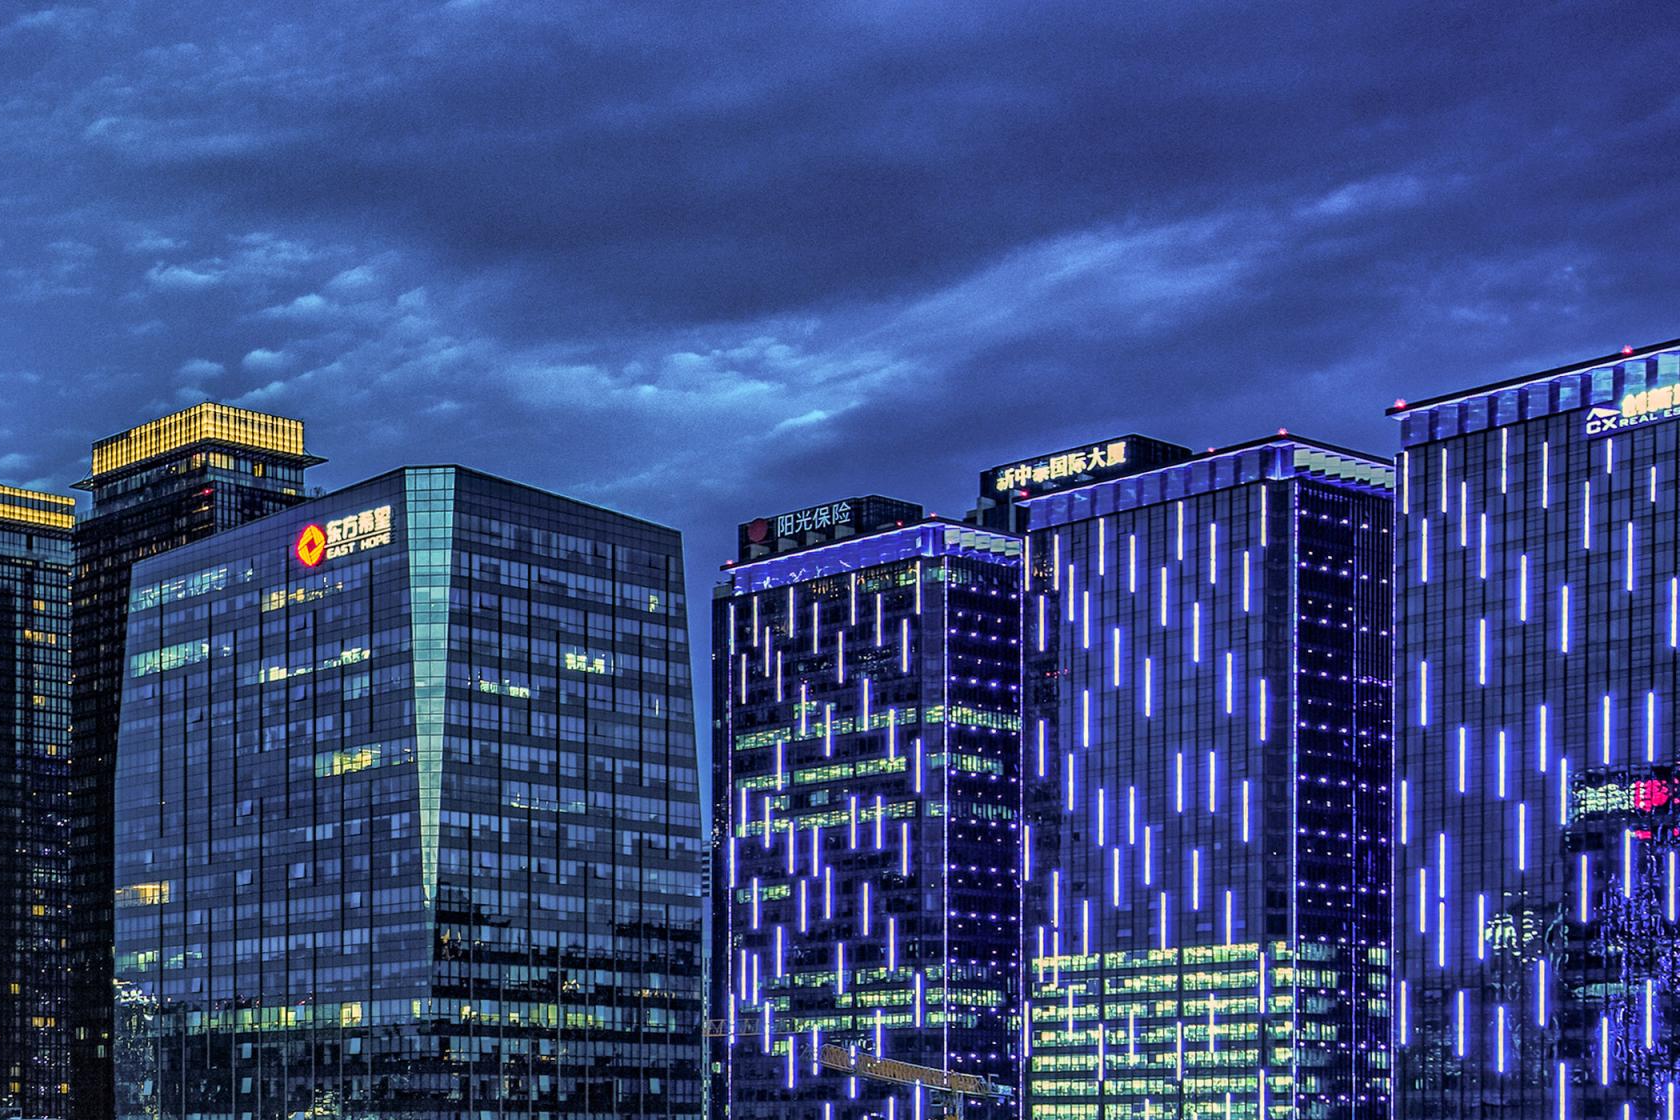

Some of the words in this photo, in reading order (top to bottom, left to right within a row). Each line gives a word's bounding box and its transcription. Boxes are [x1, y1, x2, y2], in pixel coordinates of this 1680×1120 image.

[1619, 413, 1658, 428] REAL
[996, 441, 1127, 491] 新中泰国际大厦
[326, 505, 391, 544] 东方希望
[777, 502, 851, 537] 阳光保险
[326, 542, 356, 560] EAST
[360, 532, 391, 551] HOPE
